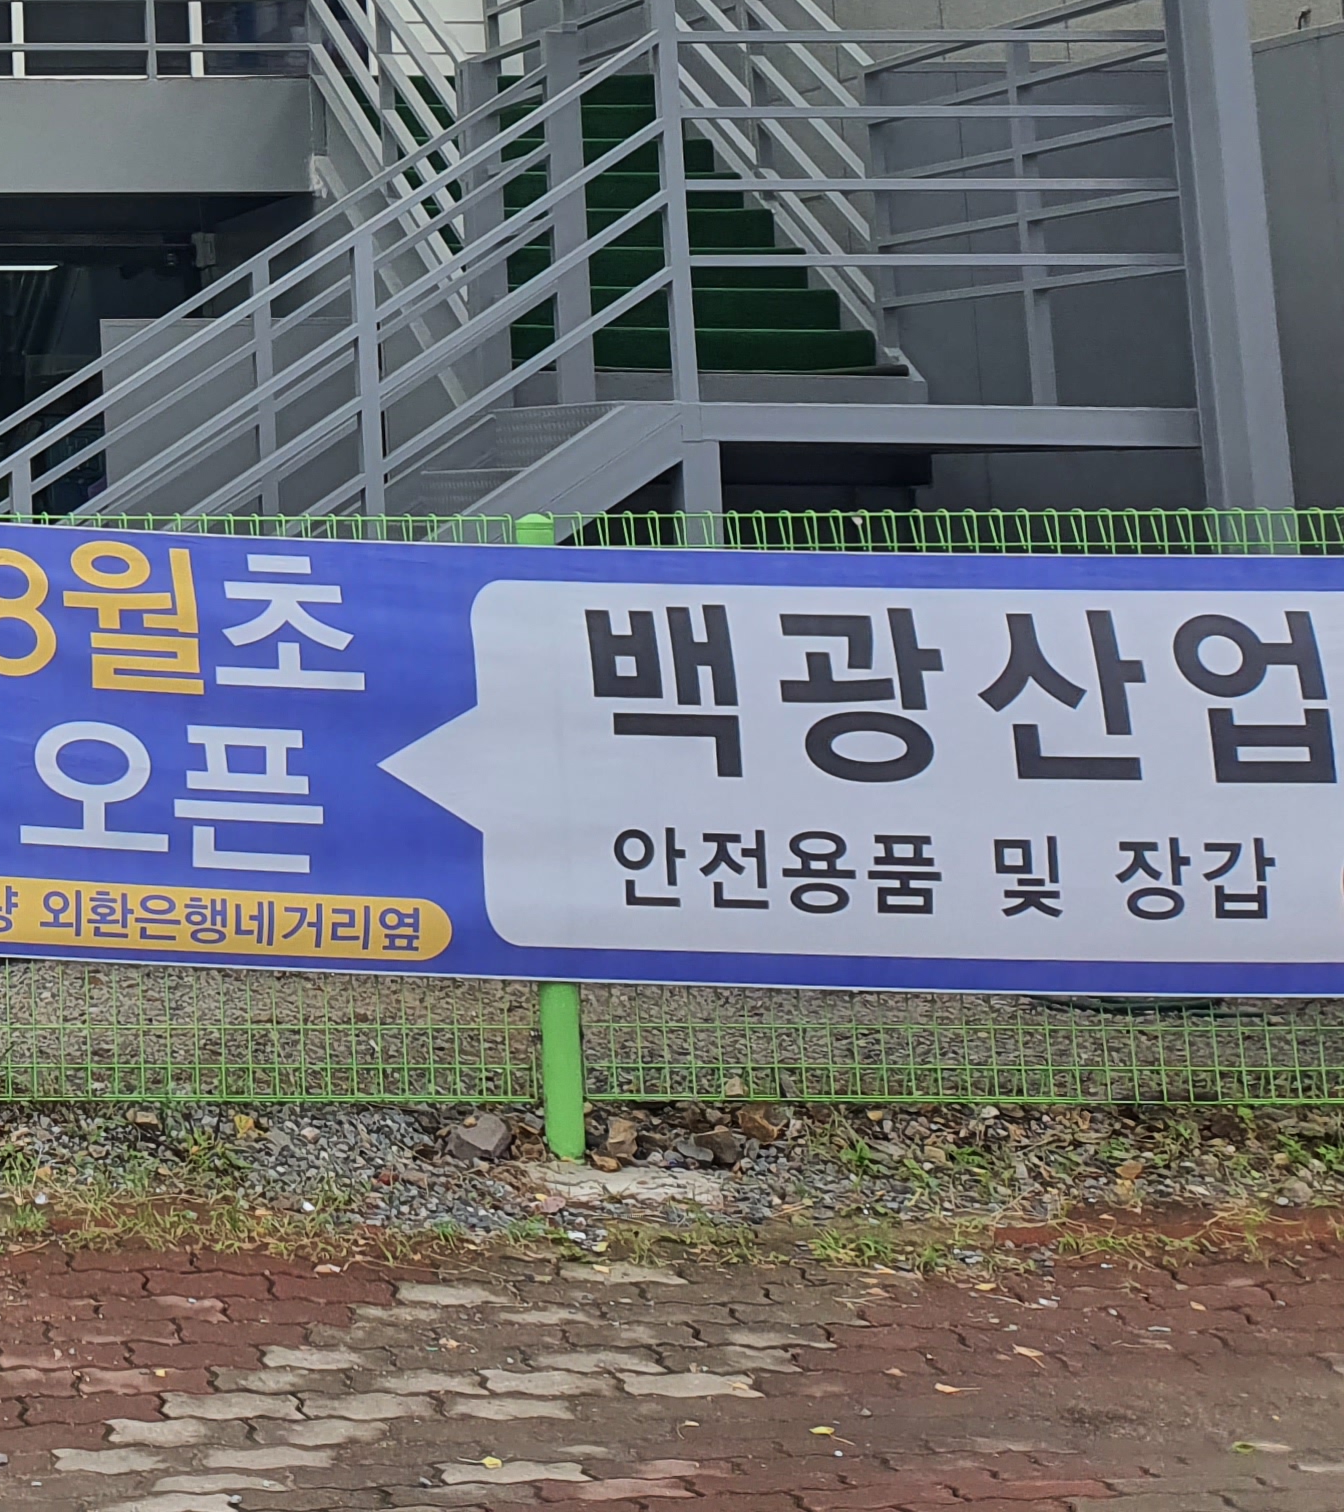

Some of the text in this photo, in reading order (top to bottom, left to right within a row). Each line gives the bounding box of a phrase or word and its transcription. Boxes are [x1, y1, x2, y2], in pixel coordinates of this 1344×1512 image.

[584, 604, 1338, 784] 백광산업
[20, 721, 324, 875] 오픈
[39, 888, 422, 954] 외환은행네거리옆
[613, 827, 1276, 921] 안전용품 및 장갑
